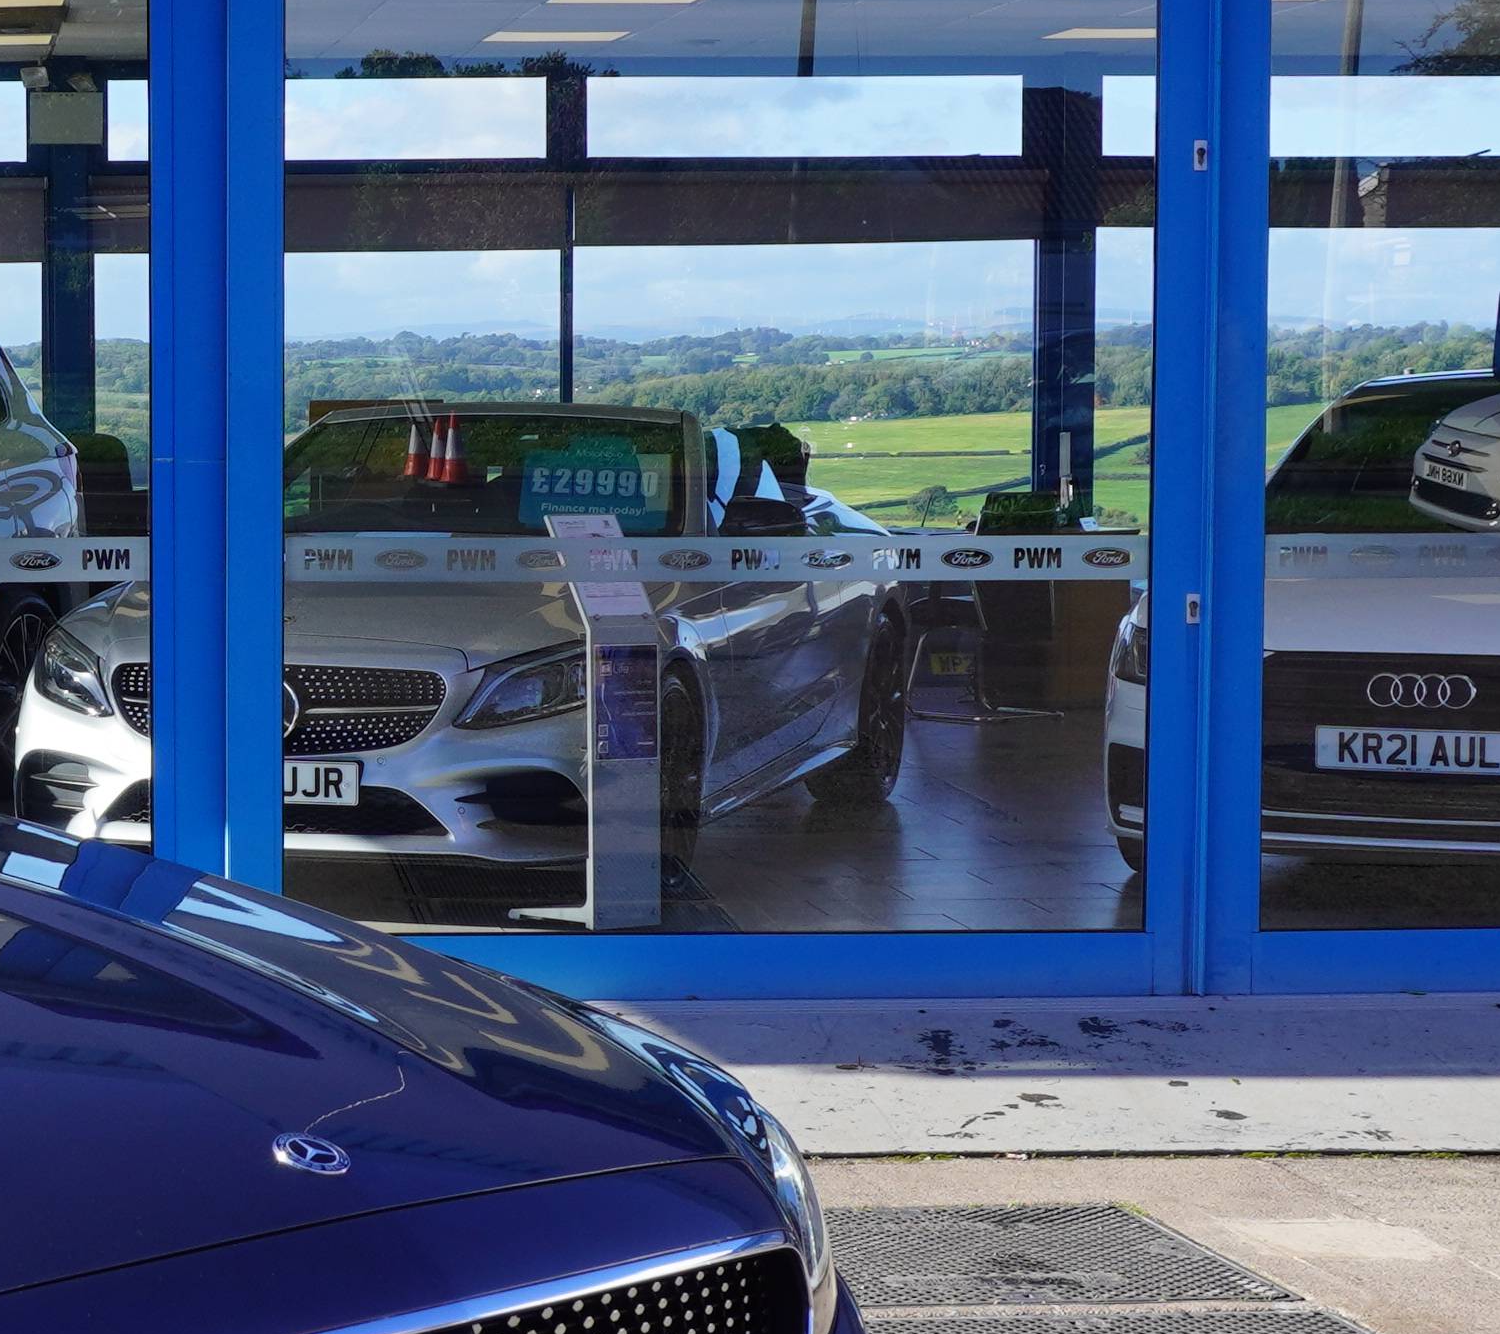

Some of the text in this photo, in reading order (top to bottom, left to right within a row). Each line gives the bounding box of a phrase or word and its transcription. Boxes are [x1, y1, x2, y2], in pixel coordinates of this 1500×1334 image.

[531, 467, 659, 498] £29990
[541, 502, 647, 517] Finance me today!
[18, 552, 54, 568] Ford
[81, 548, 131, 570] PWM
[304, 548, 354, 571] PWM
[446, 548, 497, 571] PWM
[730, 548, 781, 570] PWM
[871, 548, 922, 570] PWM
[949, 550, 984, 566] Ford
[1013, 547, 1063, 569] PWM
[1090, 550, 1126, 566] Ford
[1338, 731, 1500, 769] KR21 AUL
